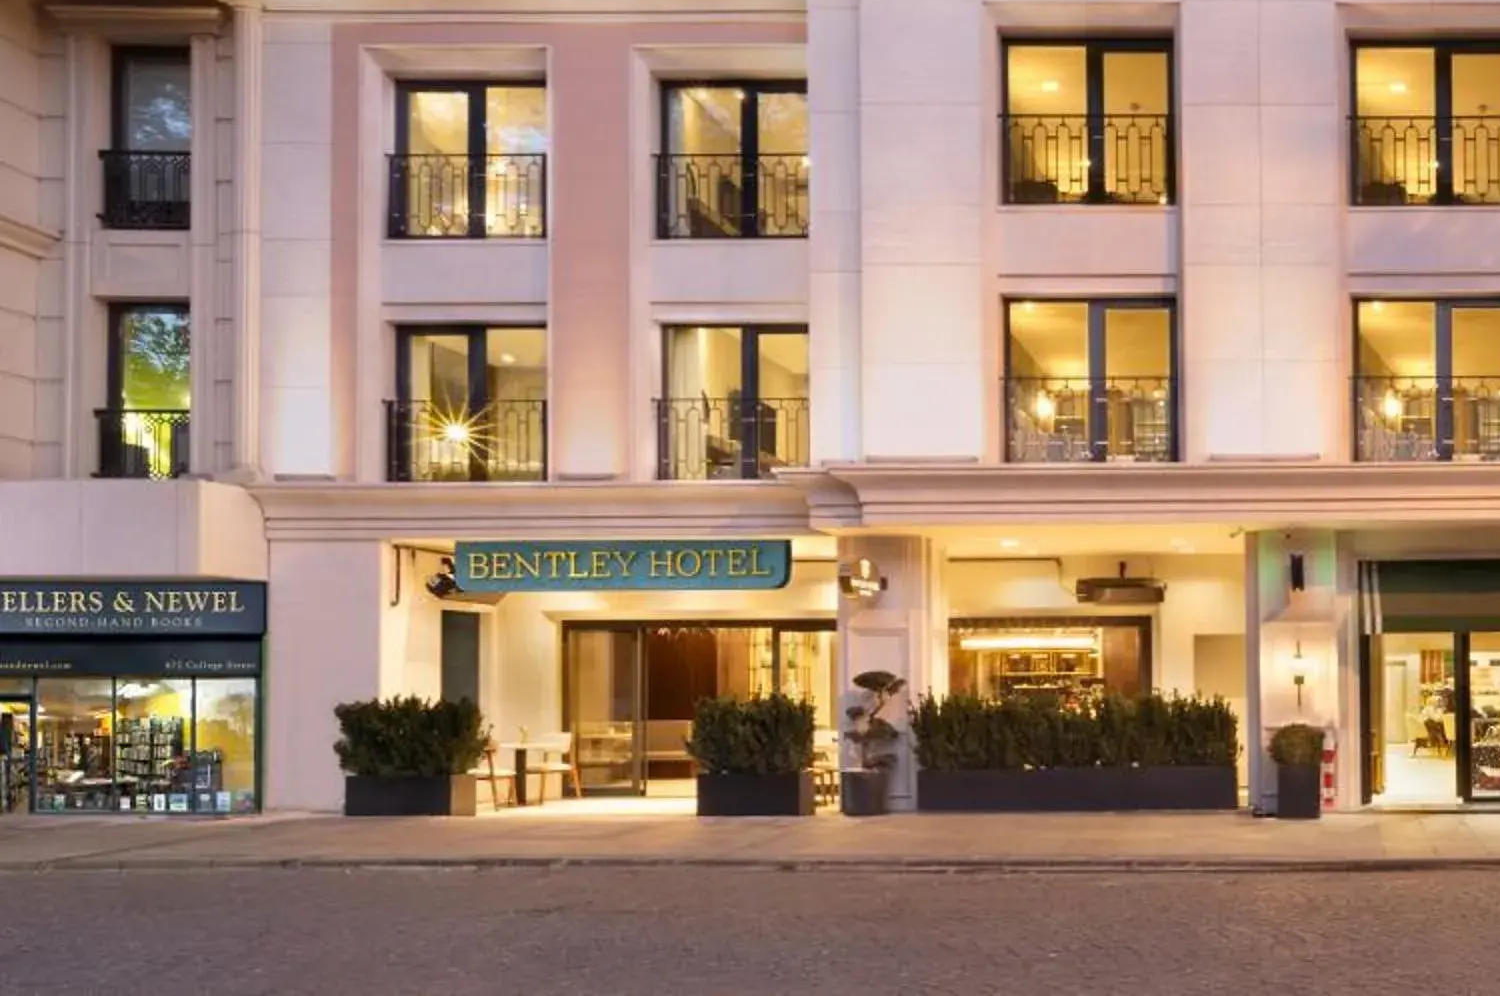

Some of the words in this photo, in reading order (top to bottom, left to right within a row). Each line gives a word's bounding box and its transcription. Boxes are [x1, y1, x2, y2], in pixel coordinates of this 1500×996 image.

[468, 550, 640, 579] BENTLEY
[650, 548, 771, 578] HOTEL
[113, 590, 135, 613] &
[144, 590, 246, 614] NEWEL
[151, 616, 204, 627] BOOKS
